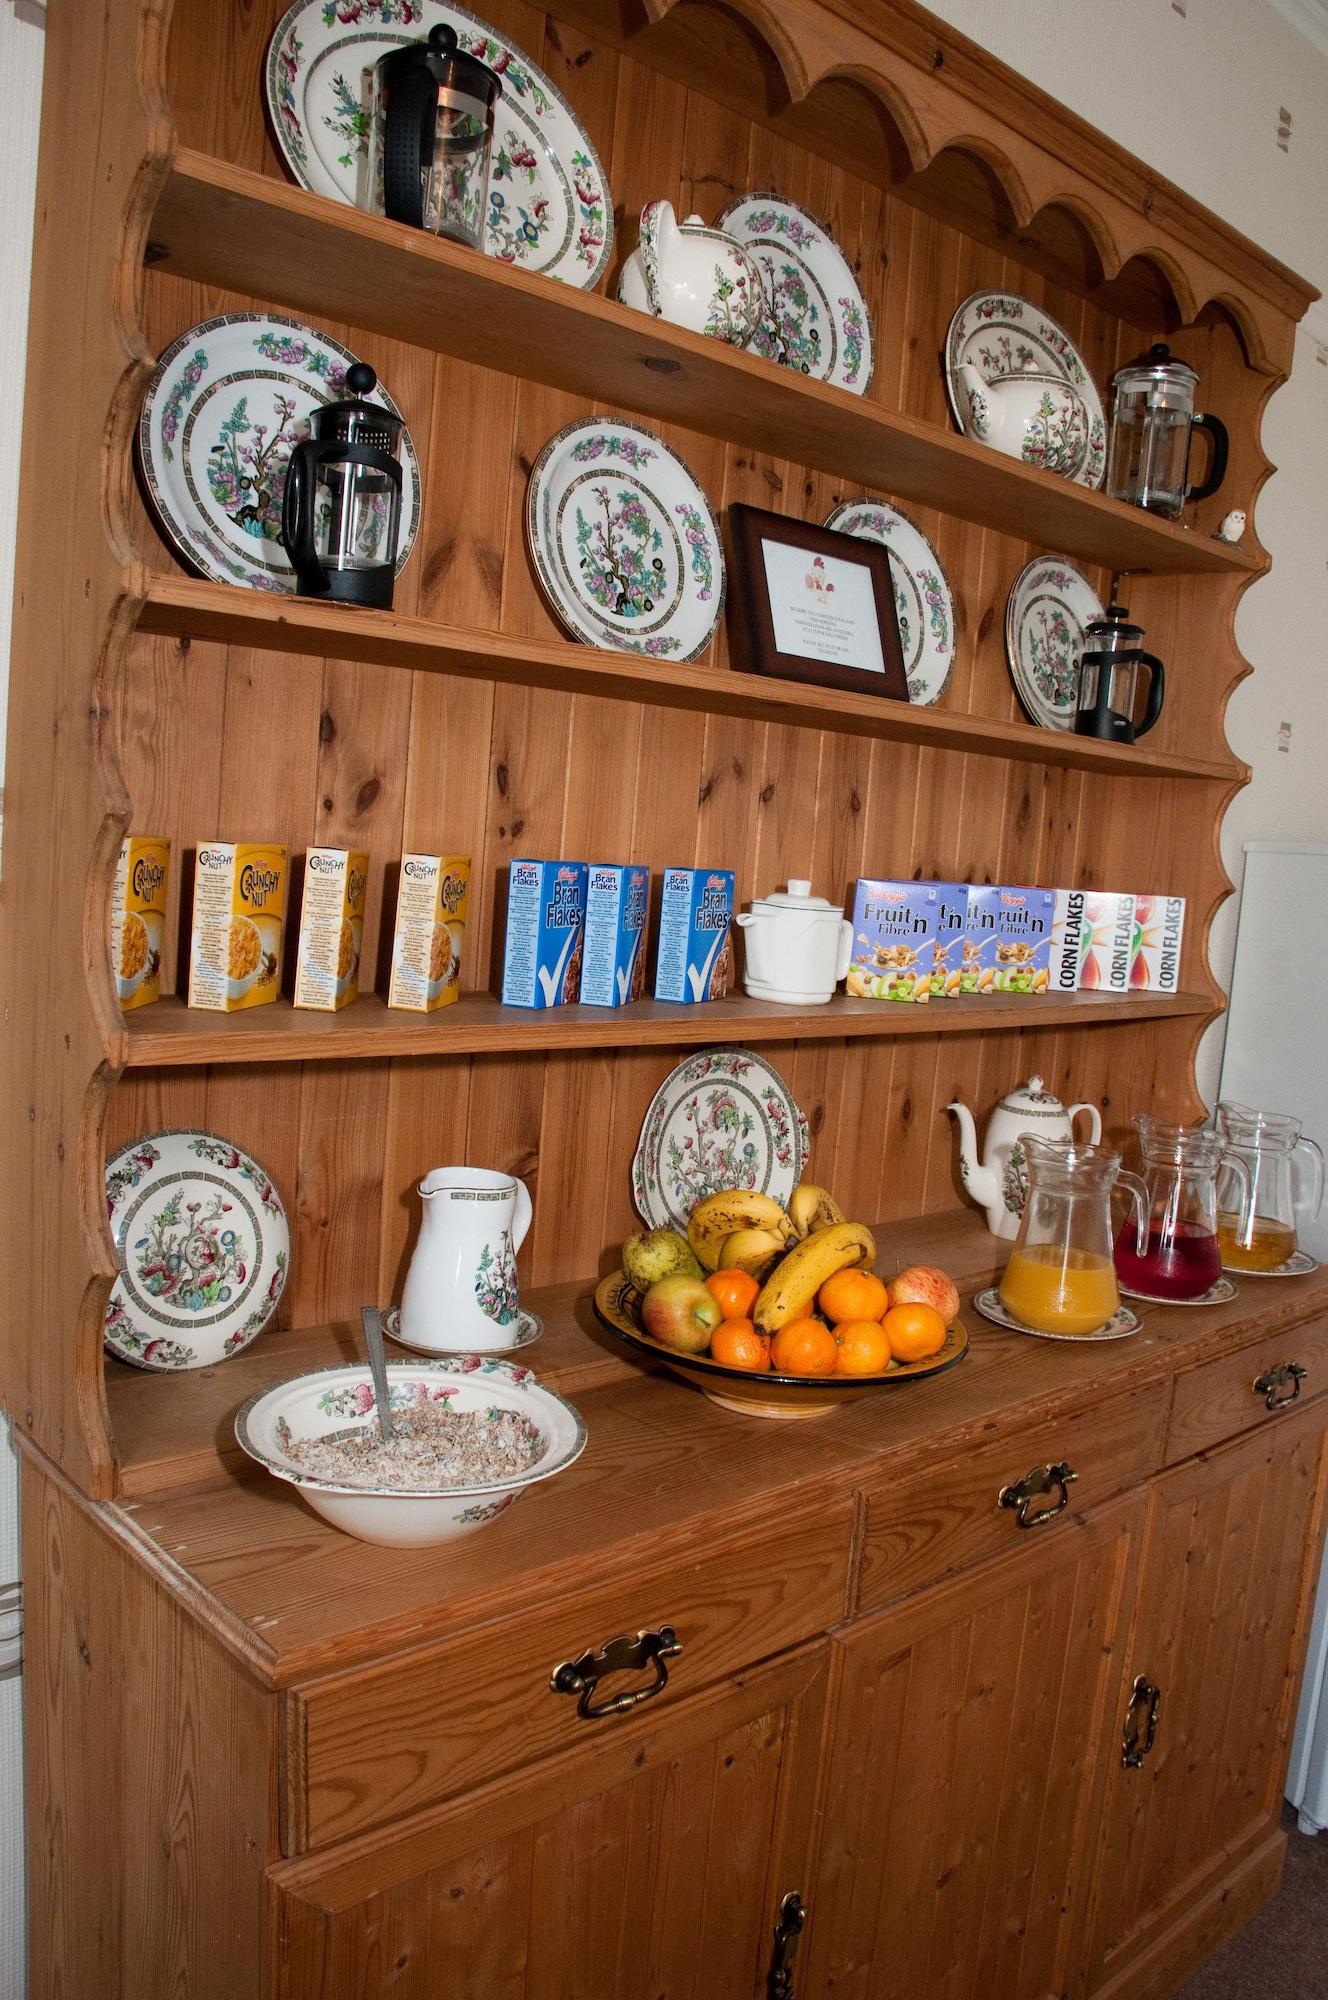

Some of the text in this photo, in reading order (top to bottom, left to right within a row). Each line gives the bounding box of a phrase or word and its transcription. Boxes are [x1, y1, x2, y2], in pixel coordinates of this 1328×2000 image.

[199, 851, 233, 866] CRUNCHY
[209, 862, 222, 870] NUT
[309, 856, 345, 870] CRUNCHY
[404, 862, 438, 876] CRUNCHY
[413, 872, 426, 880] NUT
[517, 868, 537, 879] Bran
[240, 864, 281, 901] CRUNCHY
[512, 876, 539, 887] Flakes
[591, 881, 618, 891] Flakes
[595, 873, 616, 884] Bran
[669, 875, 688, 885] Bran
[554, 880, 580, 906] Bran
[665, 882, 690, 892] Flakes
[251, 889, 267, 908] NUT
[702, 887, 728, 910] Bran
[546, 902, 582, 929] Flakes
[695, 907, 729, 930] Flakes
[864, 903, 912, 924] Fruit
[998, 907, 1030, 924] ruit
[878, 923, 910, 936] Fibre
[1060, 893, 1084, 988] CORN FLAKES
[1110, 896, 1134, 988] CORN FLAKES
[1159, 898, 1182, 989] CORN FLAKES
